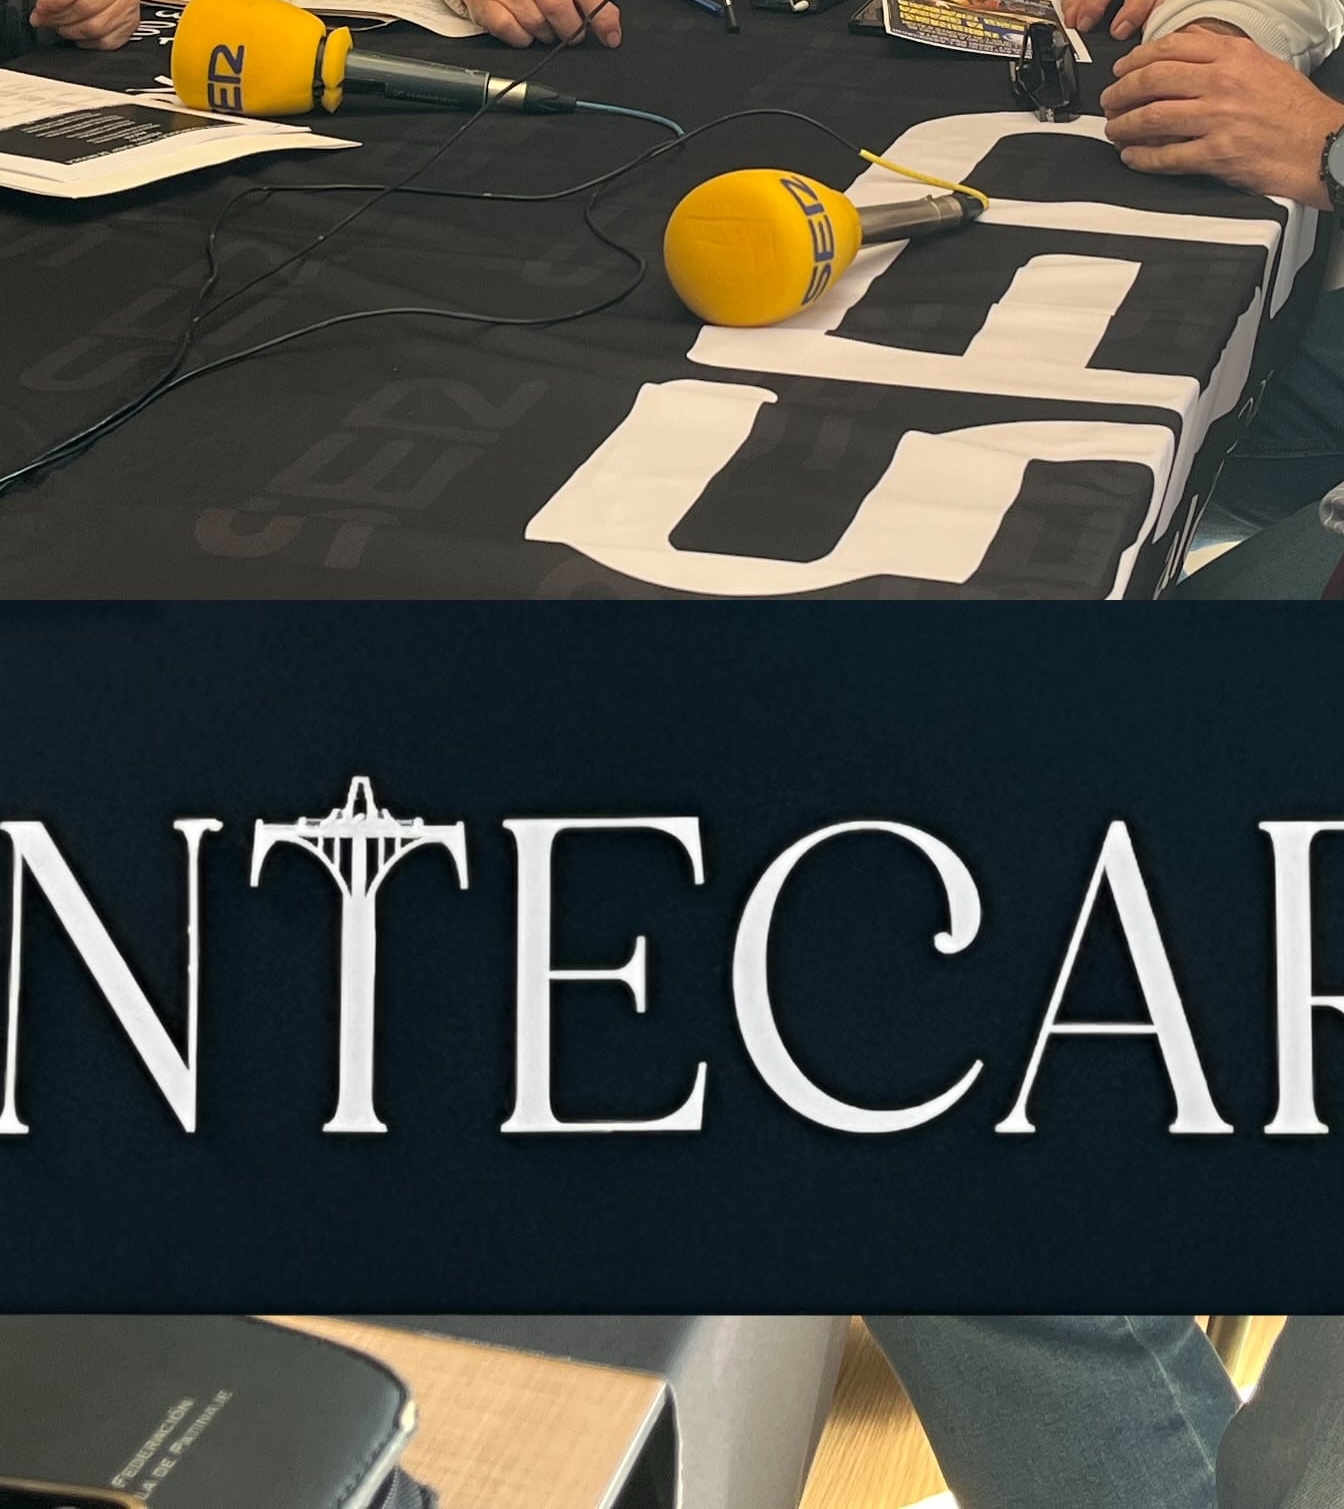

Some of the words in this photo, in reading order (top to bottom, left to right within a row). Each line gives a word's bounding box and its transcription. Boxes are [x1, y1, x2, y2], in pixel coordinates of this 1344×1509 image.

[206, 43, 246, 115] ER
[780, 175, 836, 306] SER
[111, 1396, 196, 1489] FEDERACIÓN
[152, 1456, 177, 1478] DE
